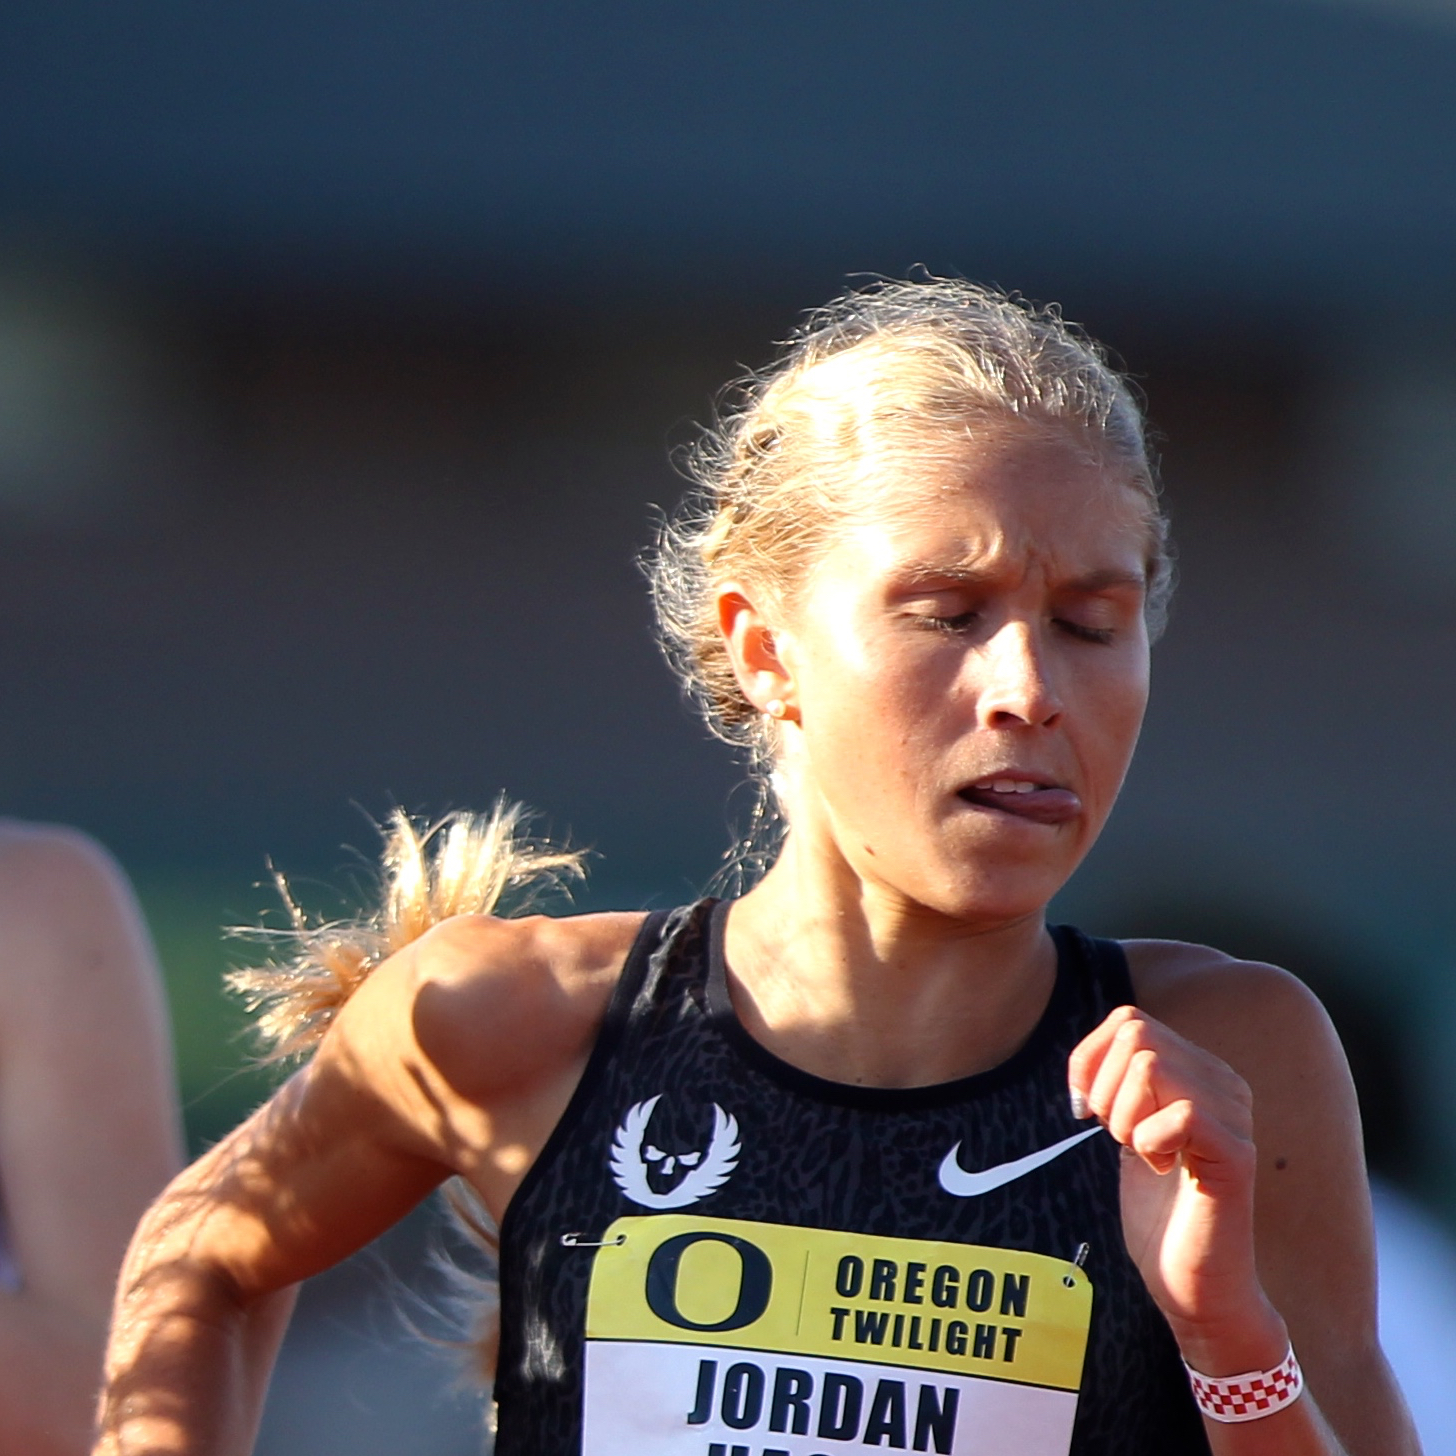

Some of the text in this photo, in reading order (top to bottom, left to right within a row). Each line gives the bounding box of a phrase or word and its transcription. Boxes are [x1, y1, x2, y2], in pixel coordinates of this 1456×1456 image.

[644, 1231, 773, 1332] O
[835, 1254, 1031, 1318] OREGON
[829, 1307, 1023, 1363] TWILIGHT
[686, 1359, 960, 1456] JORDAN
